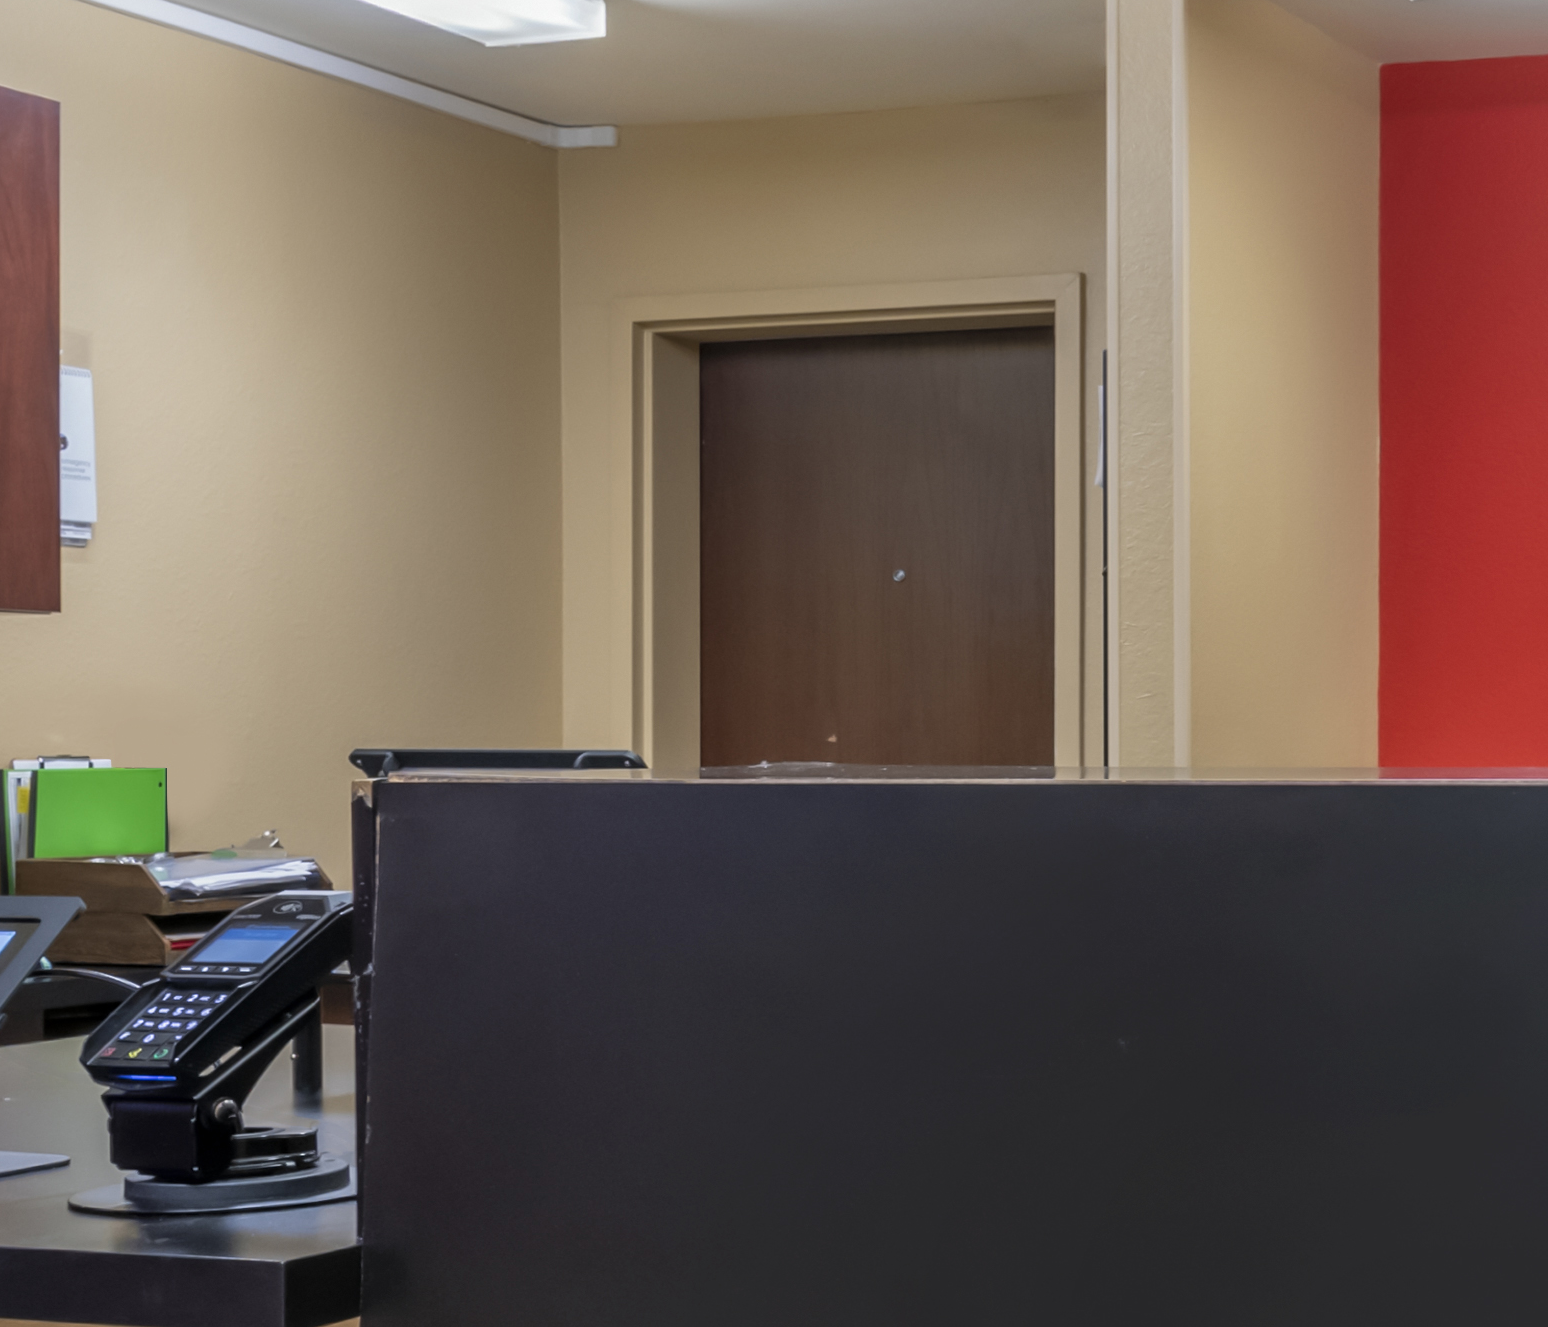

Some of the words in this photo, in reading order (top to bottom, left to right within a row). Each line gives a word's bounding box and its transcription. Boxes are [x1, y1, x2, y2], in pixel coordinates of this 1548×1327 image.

[162, 992, 171, 1001] 1
[186, 993, 199, 1002] 2
[214, 994, 227, 1004] 3
[147, 1006, 158, 1014] 4
[172, 1006, 185, 1016] 5
[200, 1007, 213, 1016] 6
[132, 1019, 144, 1028] 7
[142, 1033, 155, 1043] 0
